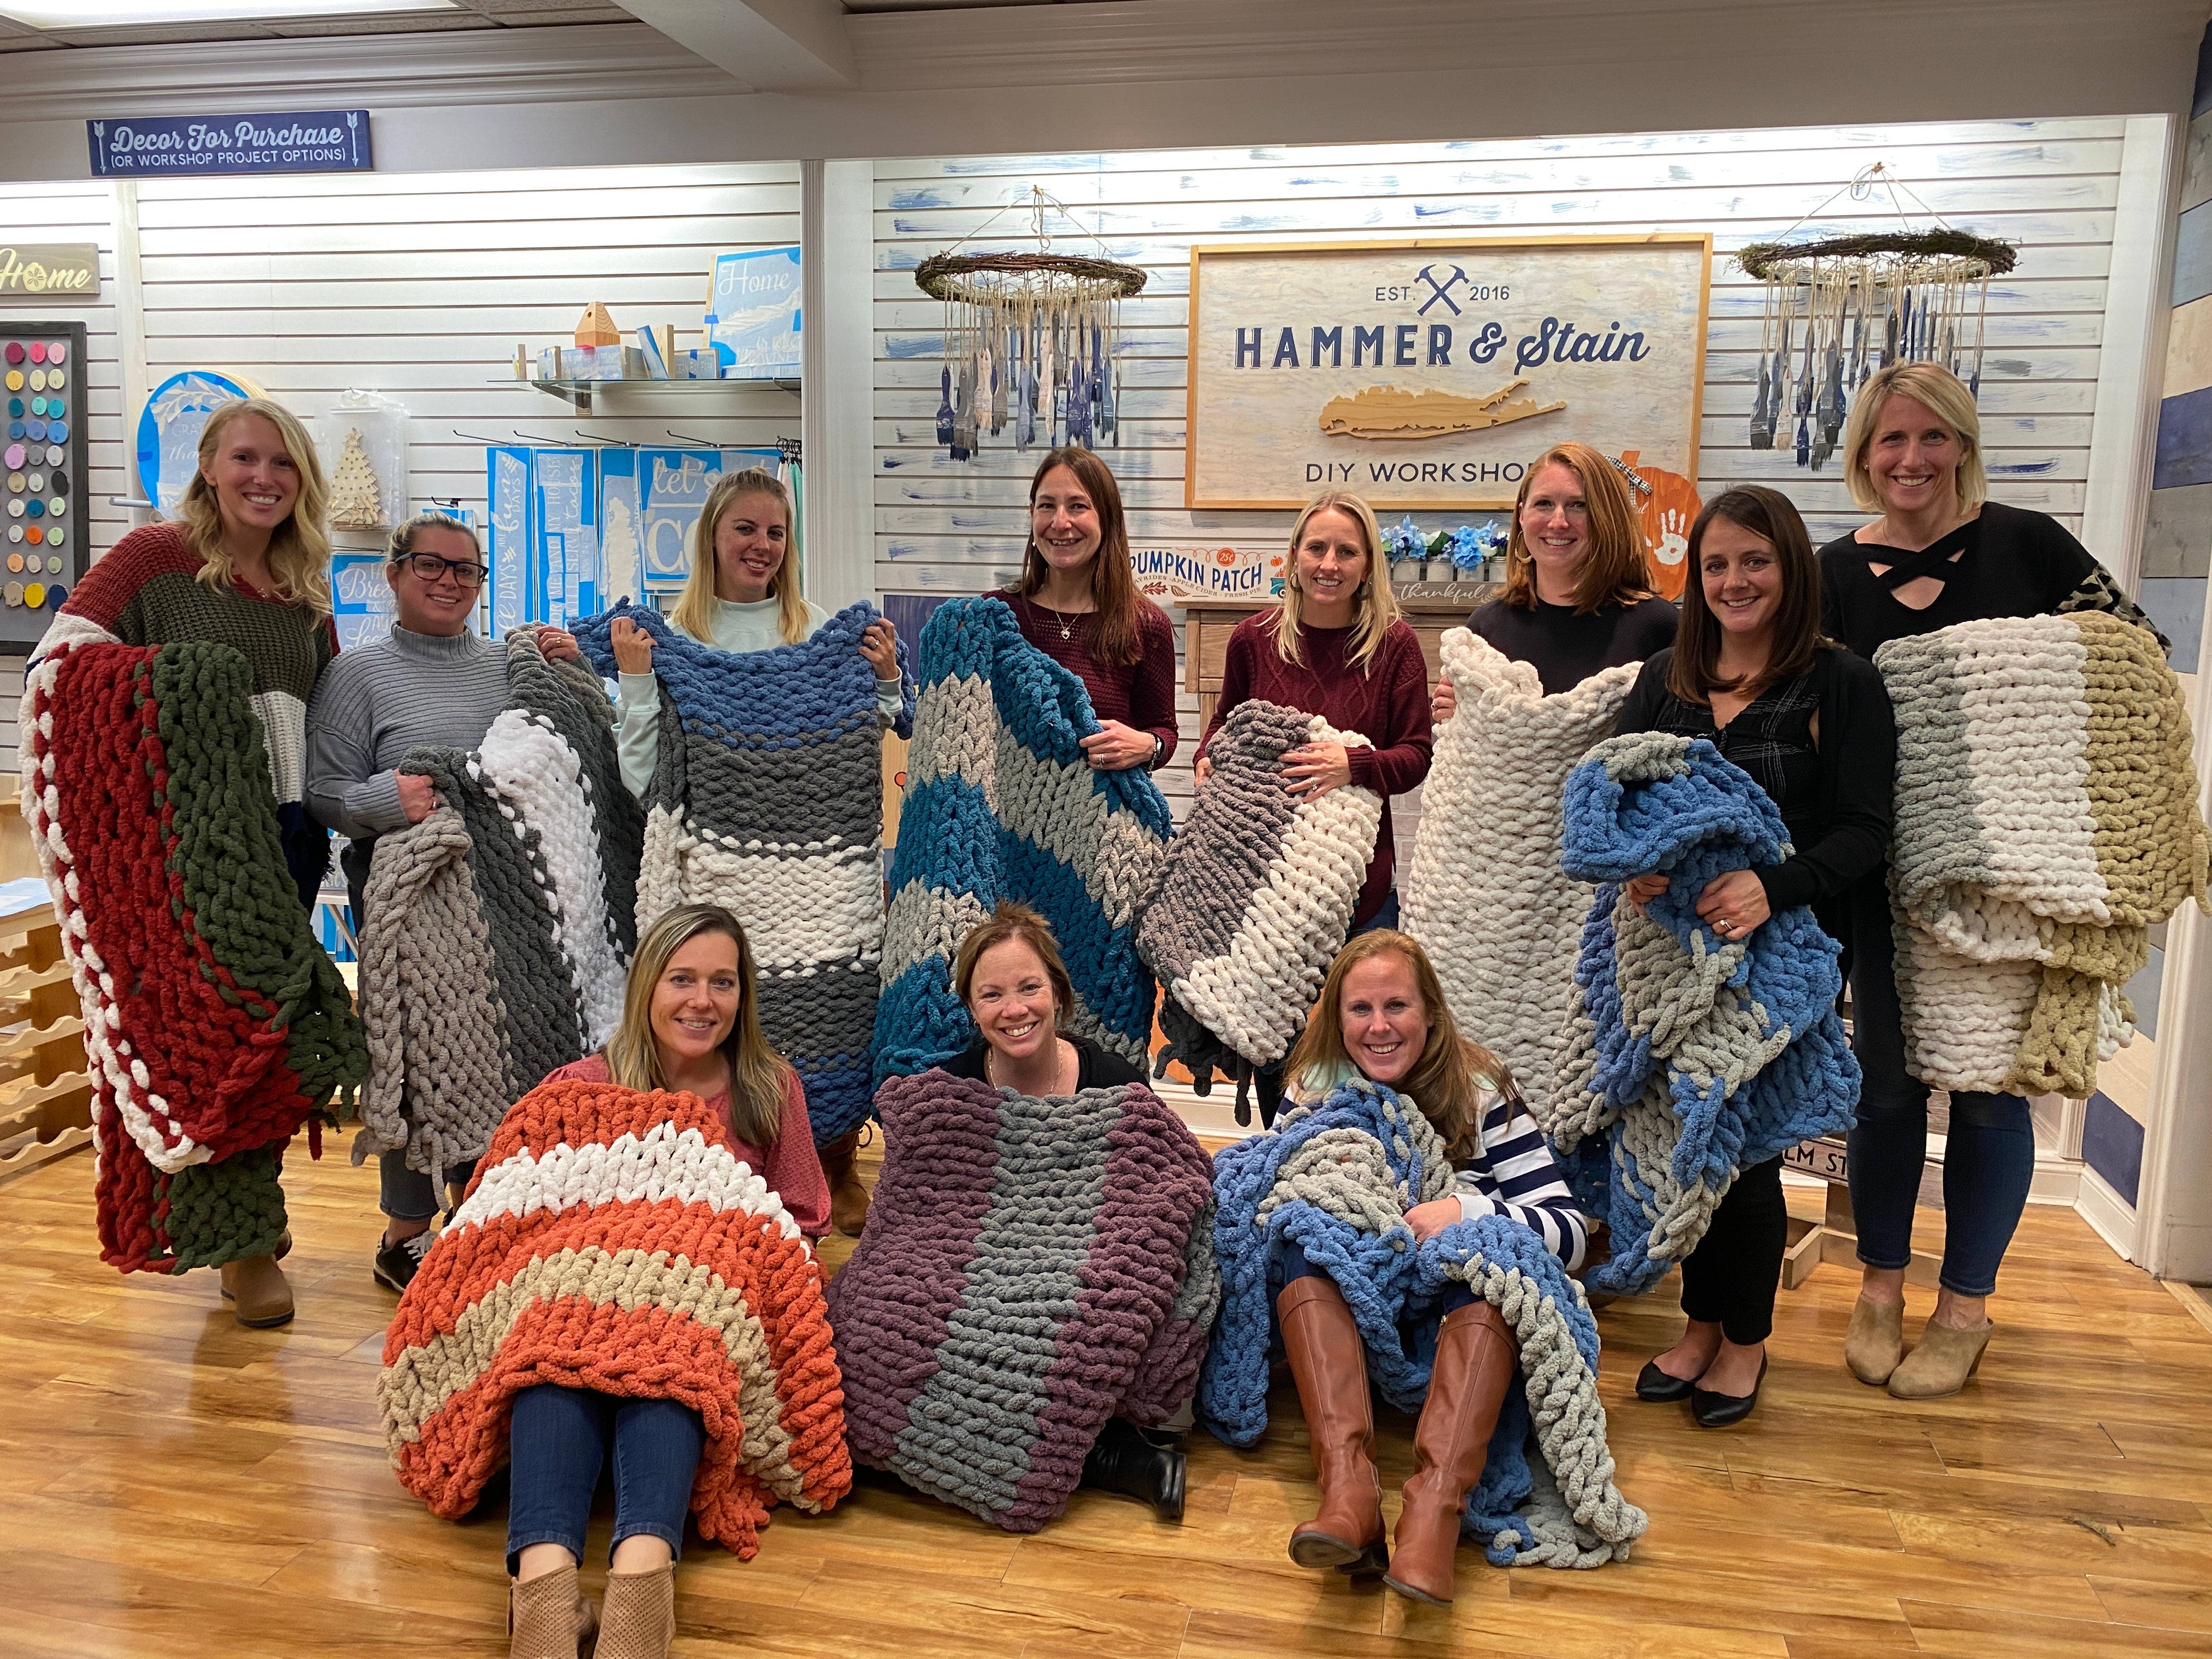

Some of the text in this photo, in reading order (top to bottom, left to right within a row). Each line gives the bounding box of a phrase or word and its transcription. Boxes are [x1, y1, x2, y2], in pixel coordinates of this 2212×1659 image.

[110, 121, 344, 153] Decor For Purchase
[111, 147, 346, 168] (OR WORKSHOP PROJECT OPTIONS)
[718, 259, 792, 295] Home
[1375, 285, 1510, 301] EST. 2016
[1234, 317, 1651, 376] HAMMER & Stain
[547, 460, 560, 504] HOUSE
[1306, 462, 1534, 482] DIY WORKSHO
[494, 470, 519, 532] fun
[511, 477, 521, 512] DAYS
[548, 514, 560, 532] MY
[498, 532, 506, 548] ARE
[549, 540, 562, 568] AND
[498, 564, 517, 599] DAYS
[549, 577, 562, 595] ME
[1212, 562, 1262, 591] PATCH
[1195, 586, 1217, 596] CIDER
[1250, 587, 1261, 595] PIE
[1394, 583, 1486, 604] thankful
